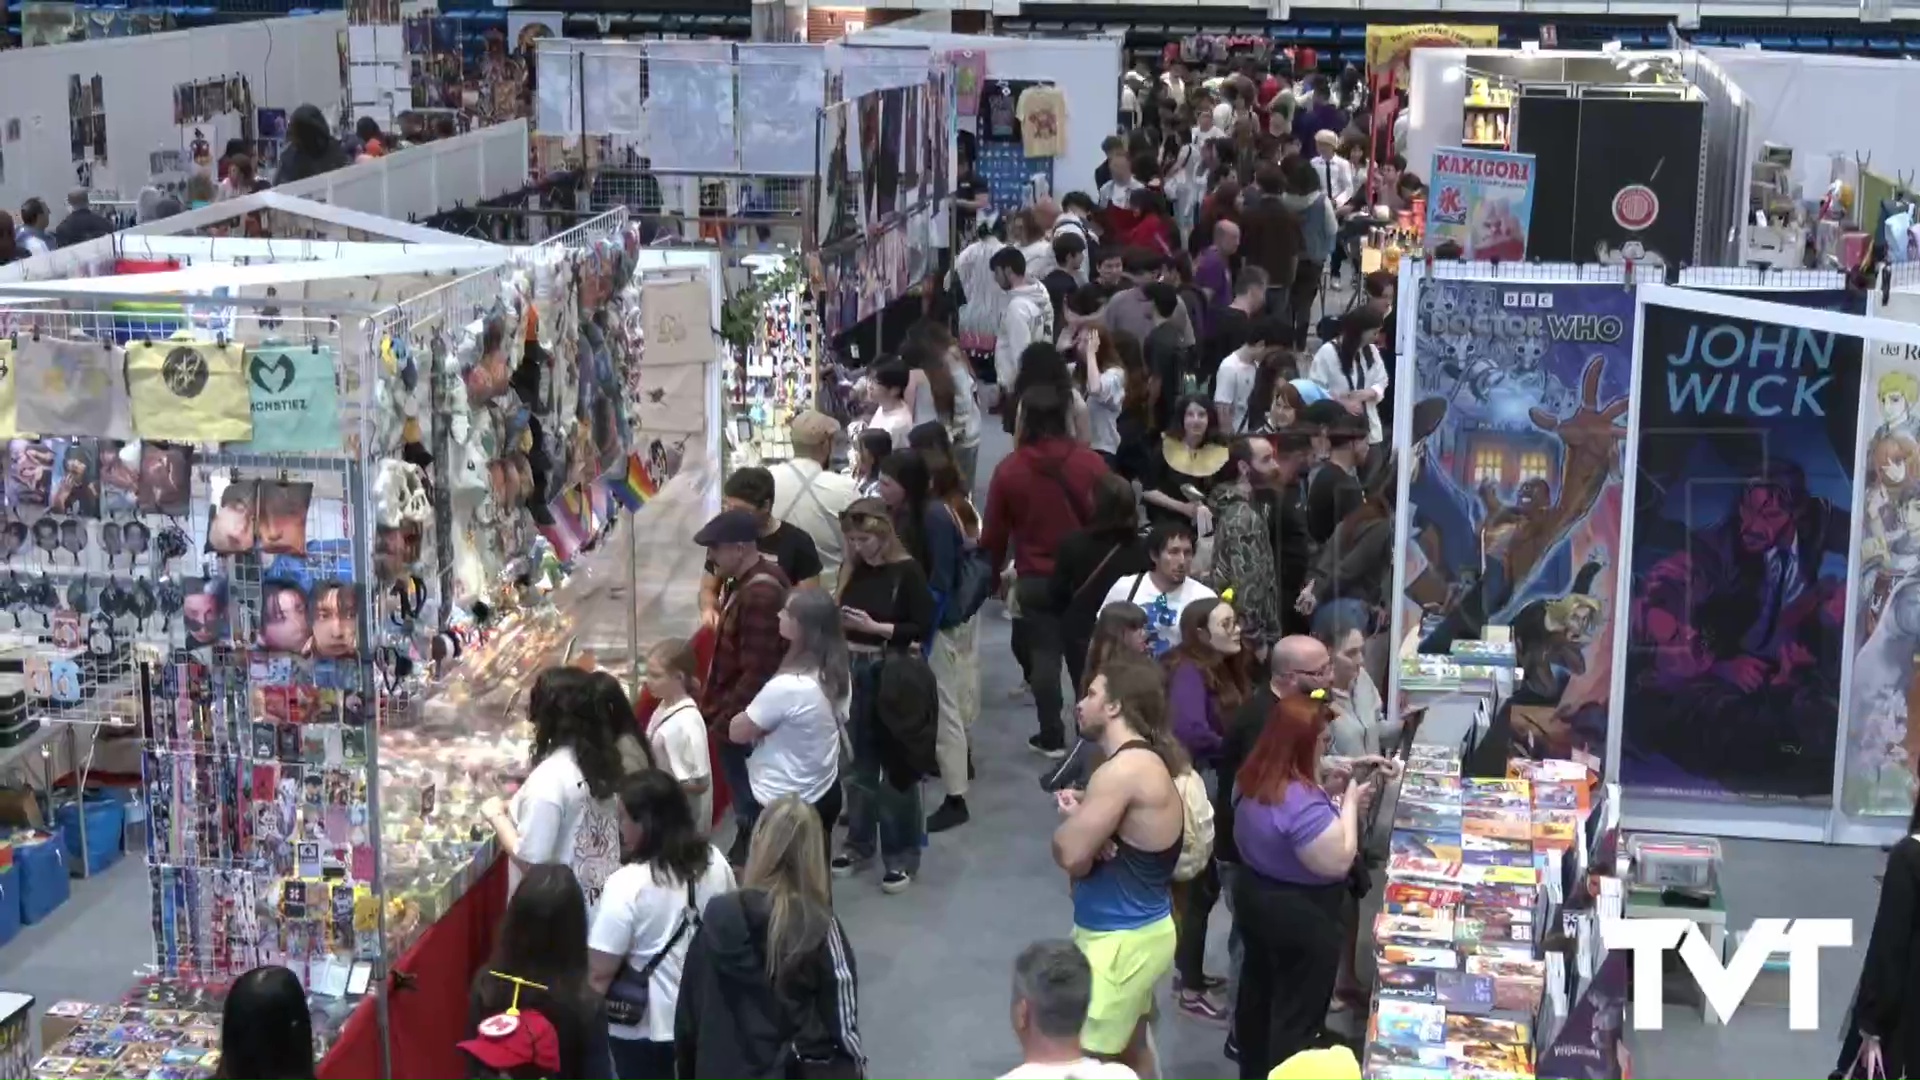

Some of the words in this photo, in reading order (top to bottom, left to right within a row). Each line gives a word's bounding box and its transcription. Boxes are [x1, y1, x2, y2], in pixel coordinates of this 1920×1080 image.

[1436, 154, 1529, 181] KAKIGORI
[1429, 312, 1542, 338] DOCTOR
[1547, 314, 1623, 342] WHO
[1667, 324, 1835, 369] JOHN
[1667, 371, 1834, 417] WICK
